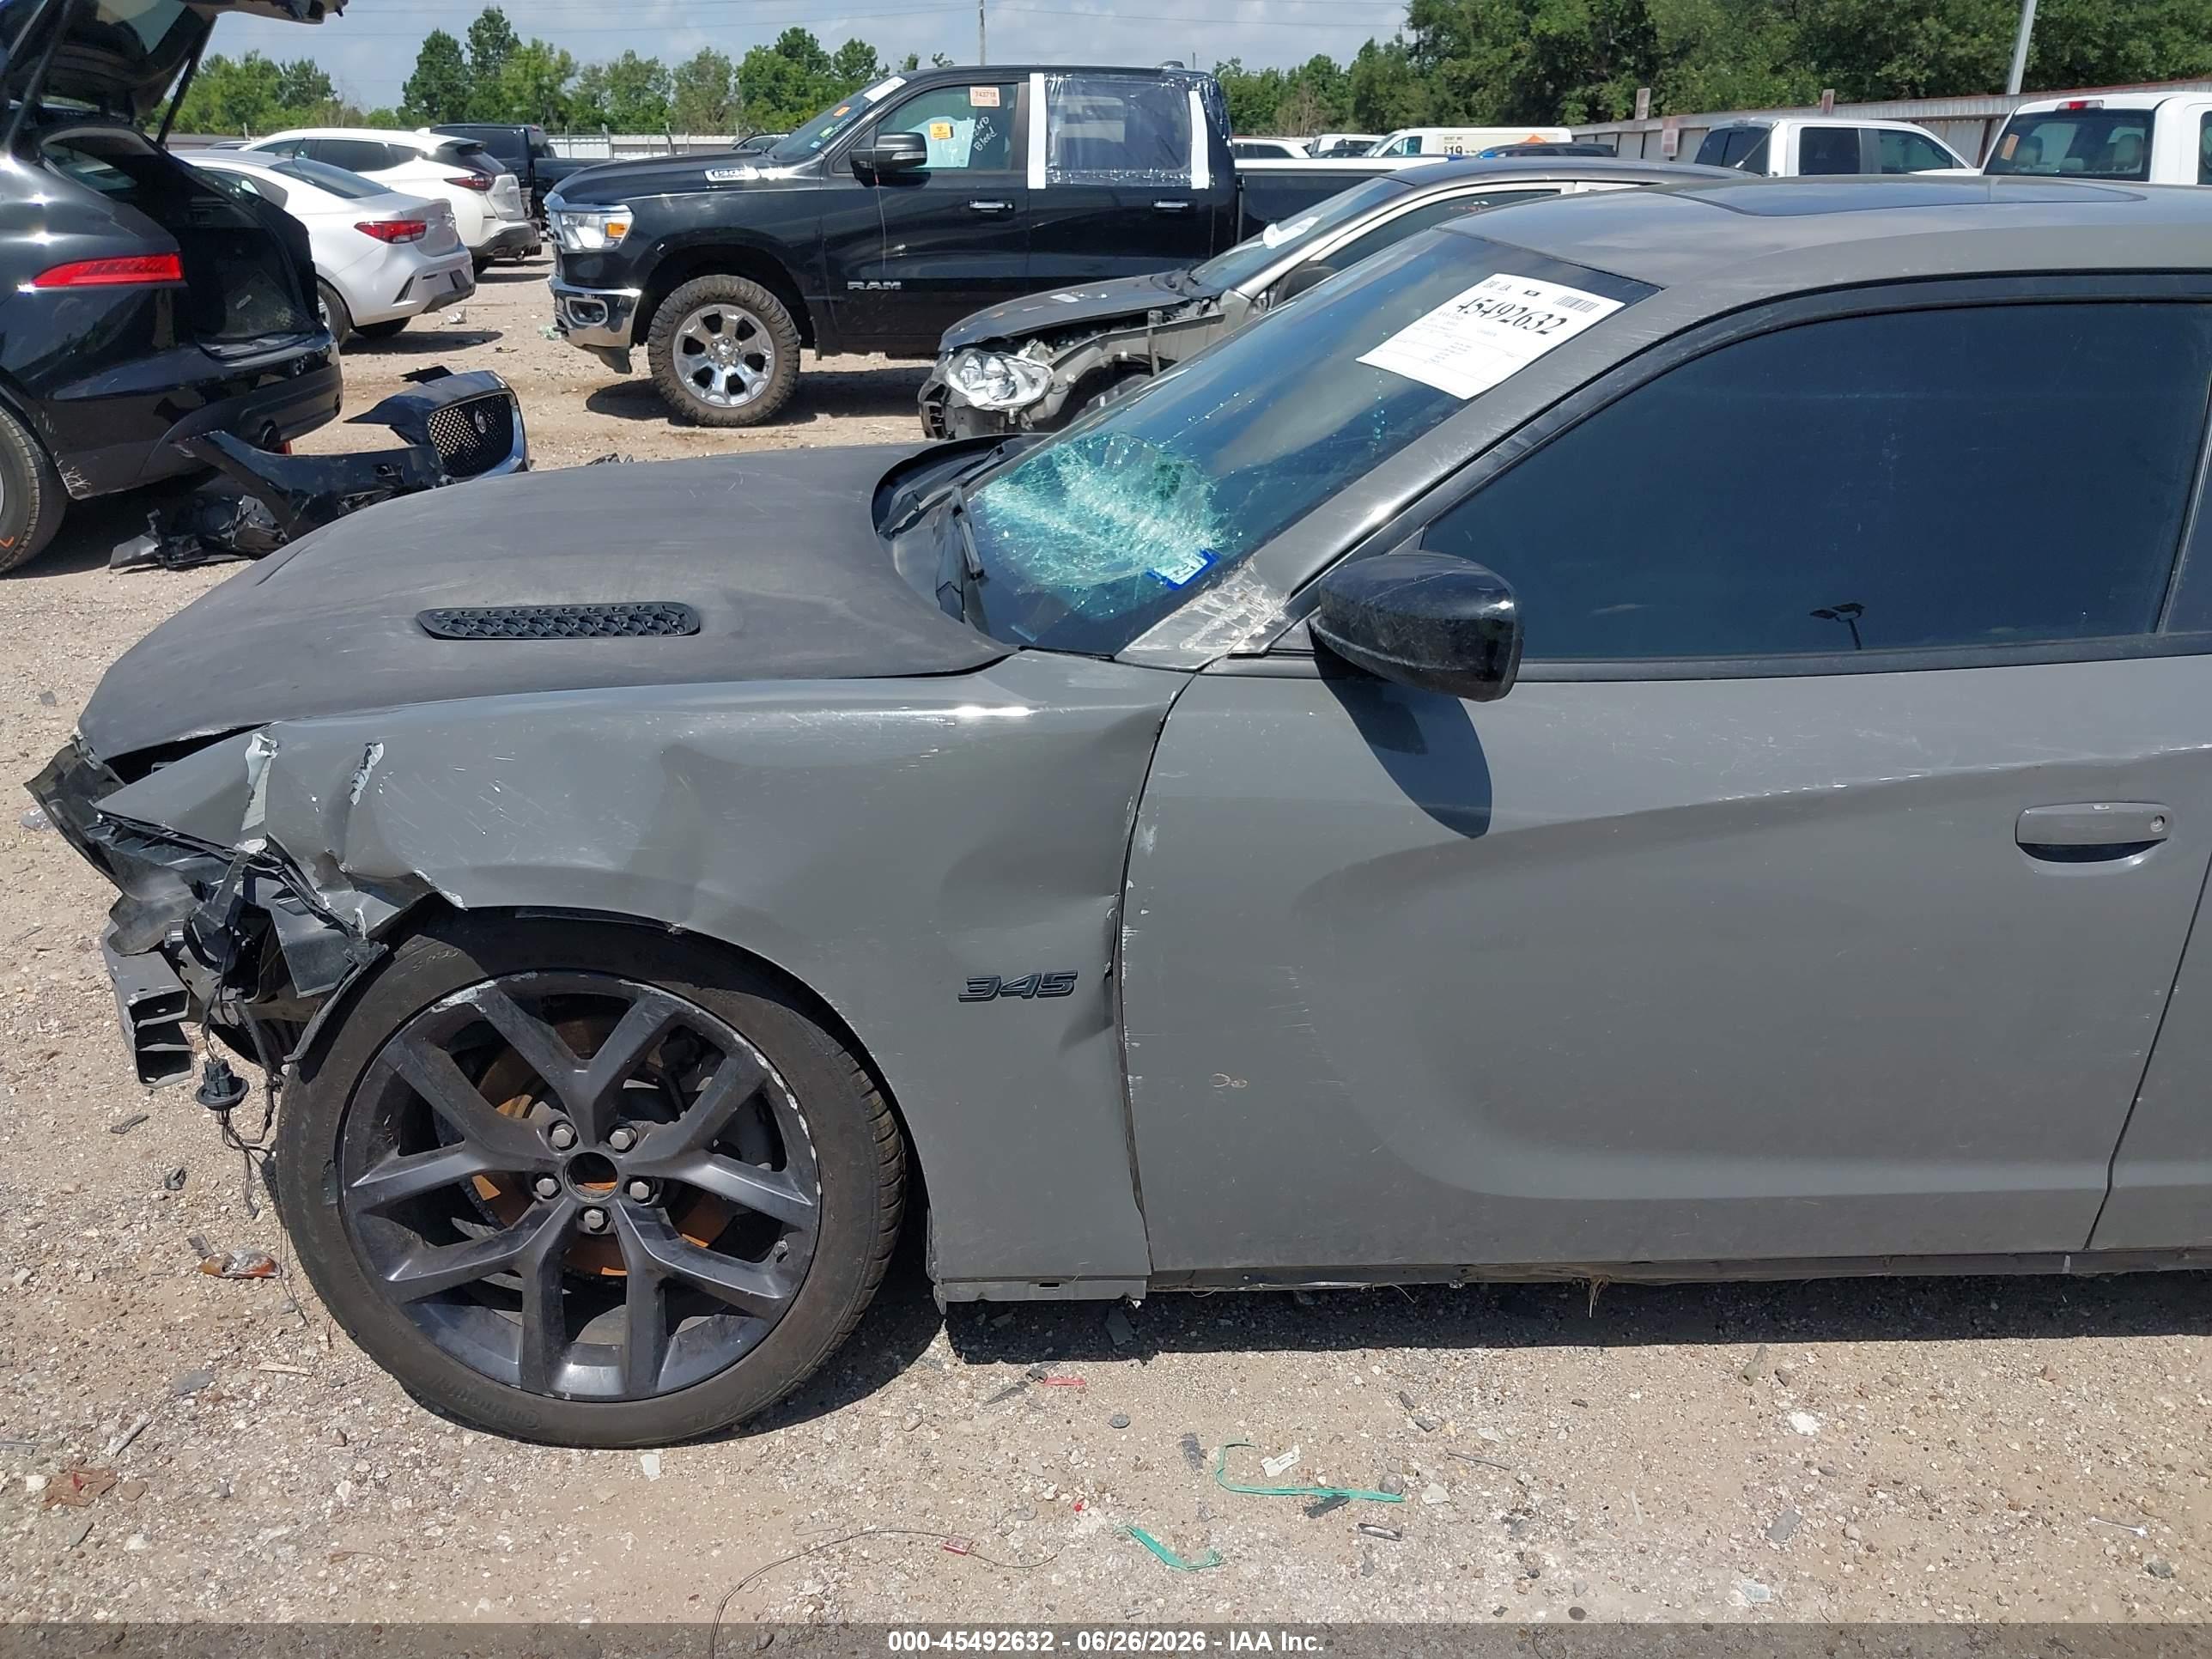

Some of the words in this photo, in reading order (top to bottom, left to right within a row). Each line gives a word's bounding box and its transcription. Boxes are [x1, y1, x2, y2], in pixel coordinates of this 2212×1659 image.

[847, 281, 902, 290] RAM
[1455, 296, 1568, 335] 45492632
[958, 969, 1078, 1003] 345
